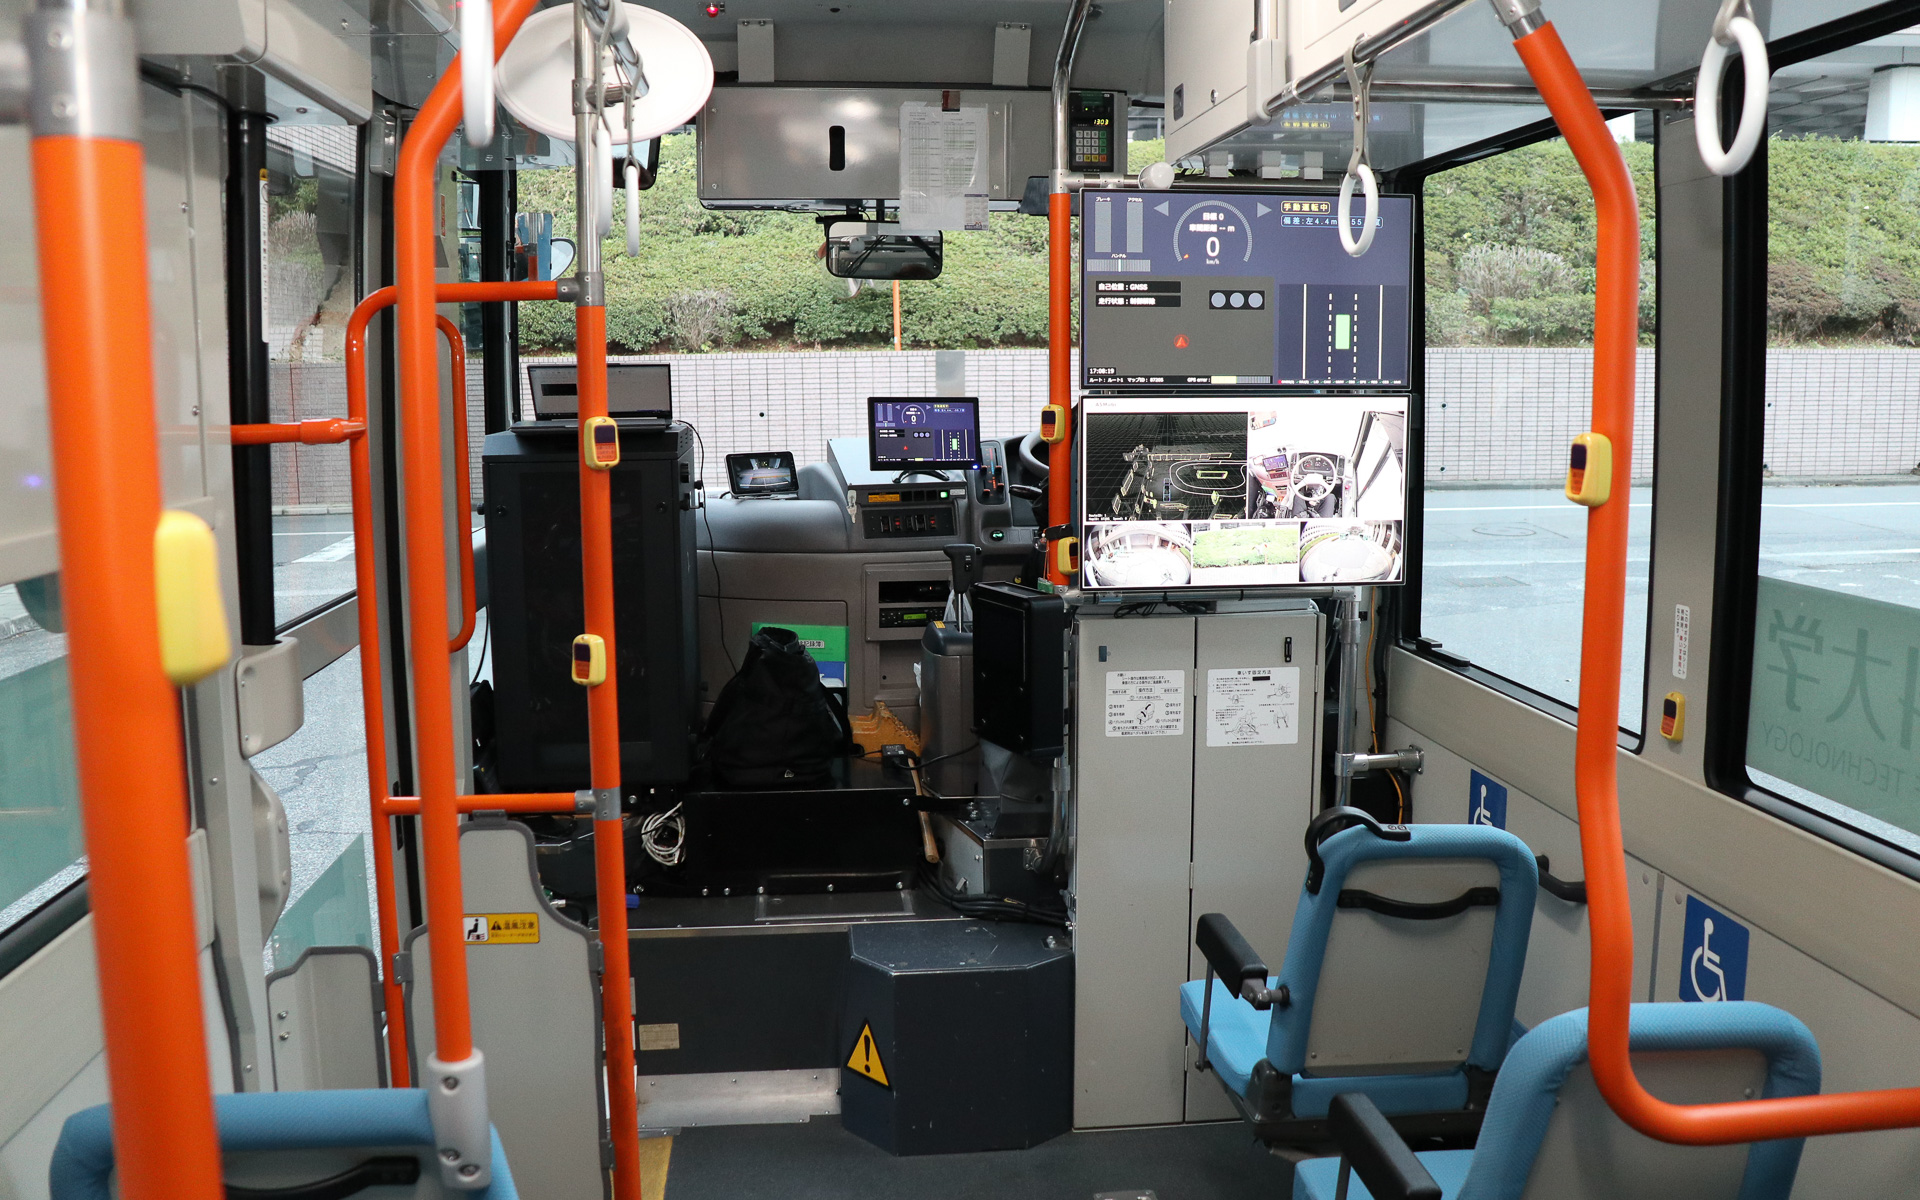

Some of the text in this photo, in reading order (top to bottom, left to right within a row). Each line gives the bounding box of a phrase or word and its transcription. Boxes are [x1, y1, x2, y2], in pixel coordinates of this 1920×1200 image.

[1283, 202, 1328, 212] 手動運転中
[1206, 236, 1220, 257] 0
